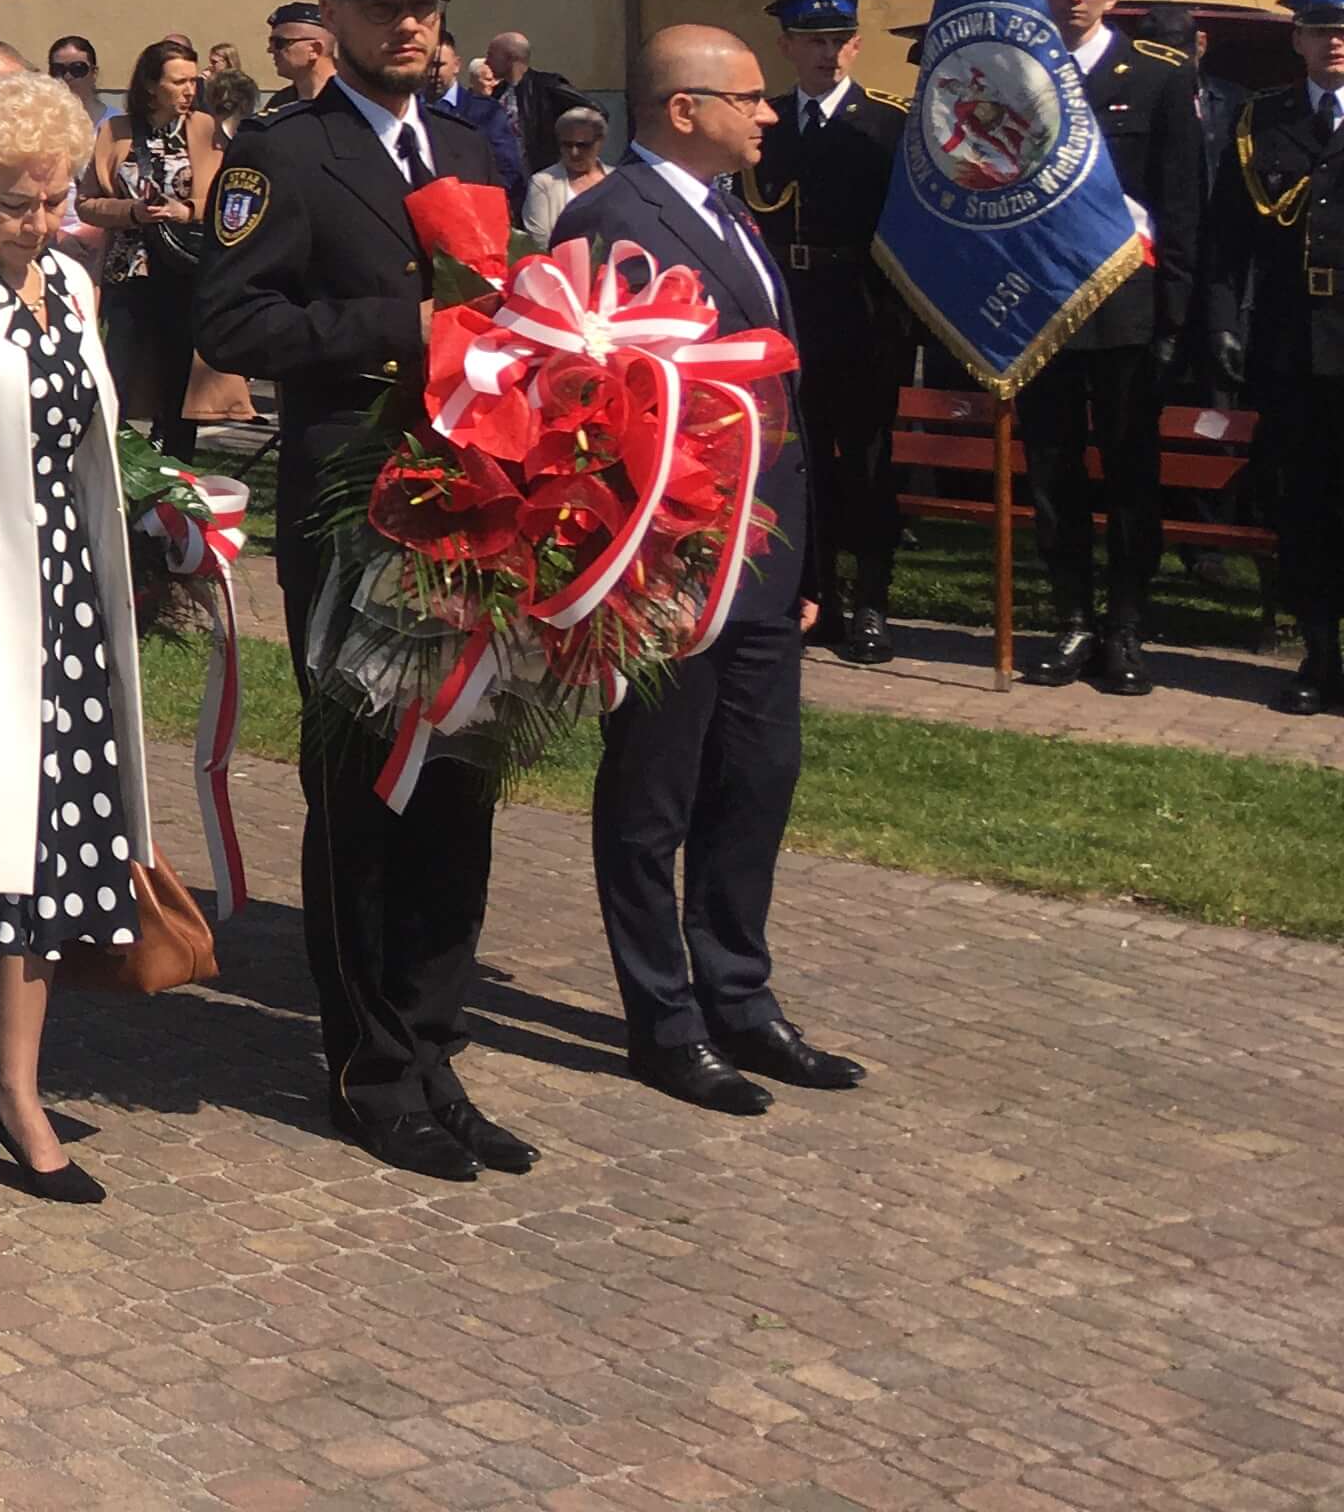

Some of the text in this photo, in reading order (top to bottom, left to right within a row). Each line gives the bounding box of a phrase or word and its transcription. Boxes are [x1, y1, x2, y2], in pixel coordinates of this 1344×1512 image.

[1004, 15, 1050, 47] PSP
[1031, 62, 1089, 195] Wielkopolskiej
[979, 271, 1031, 328] 1950
